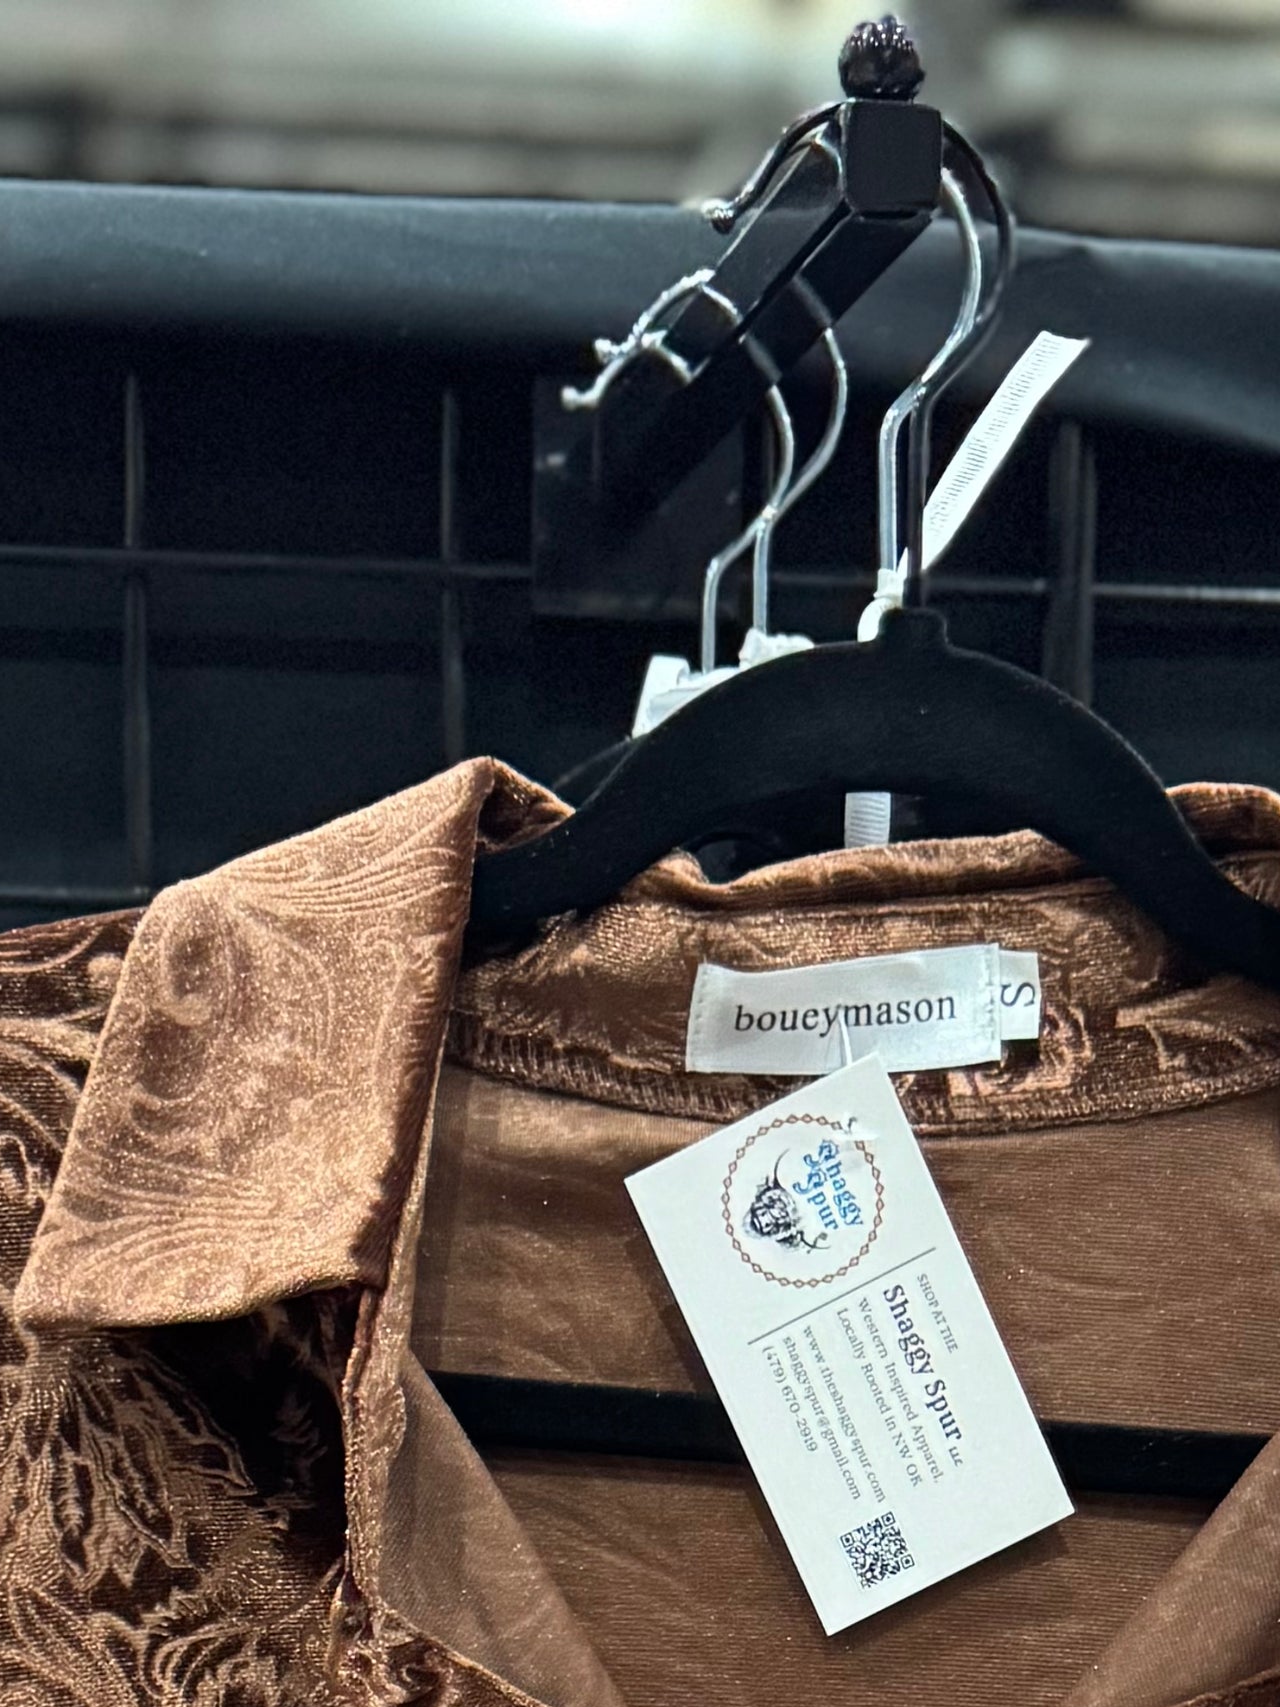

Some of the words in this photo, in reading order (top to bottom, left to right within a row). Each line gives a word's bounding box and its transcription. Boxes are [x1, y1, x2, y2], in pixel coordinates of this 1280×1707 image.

[734, 994, 958, 1038] boueymason
[1000, 980, 1037, 1008] S
[792, 1166, 839, 1230] Spur
[803, 1139, 864, 1226] Shaggy
[858, 1297, 888, 1359] Western
[885, 1362, 920, 1422] Inspired
[883, 1284, 934, 1374] Shaggy
[924, 1379, 963, 1440] Spur
[916, 1273, 941, 1309] SHOP
[931, 1310, 947, 1327] AT
[940, 1325, 959, 1353] THE
[762, 1345, 787, 1384] (479)
[781, 1386, 819, 1452] 670-2919
[783, 1336, 862, 1500] shaggyspur@gmail.com
[803, 1325, 887, 1503] www.theshaggyspur.com
[837, 1308, 866, 1360] Locally
[861, 1363, 892, 1415] Rooted
[885, 1415, 897, 1432] in
[892, 1430, 913, 1460] NW
